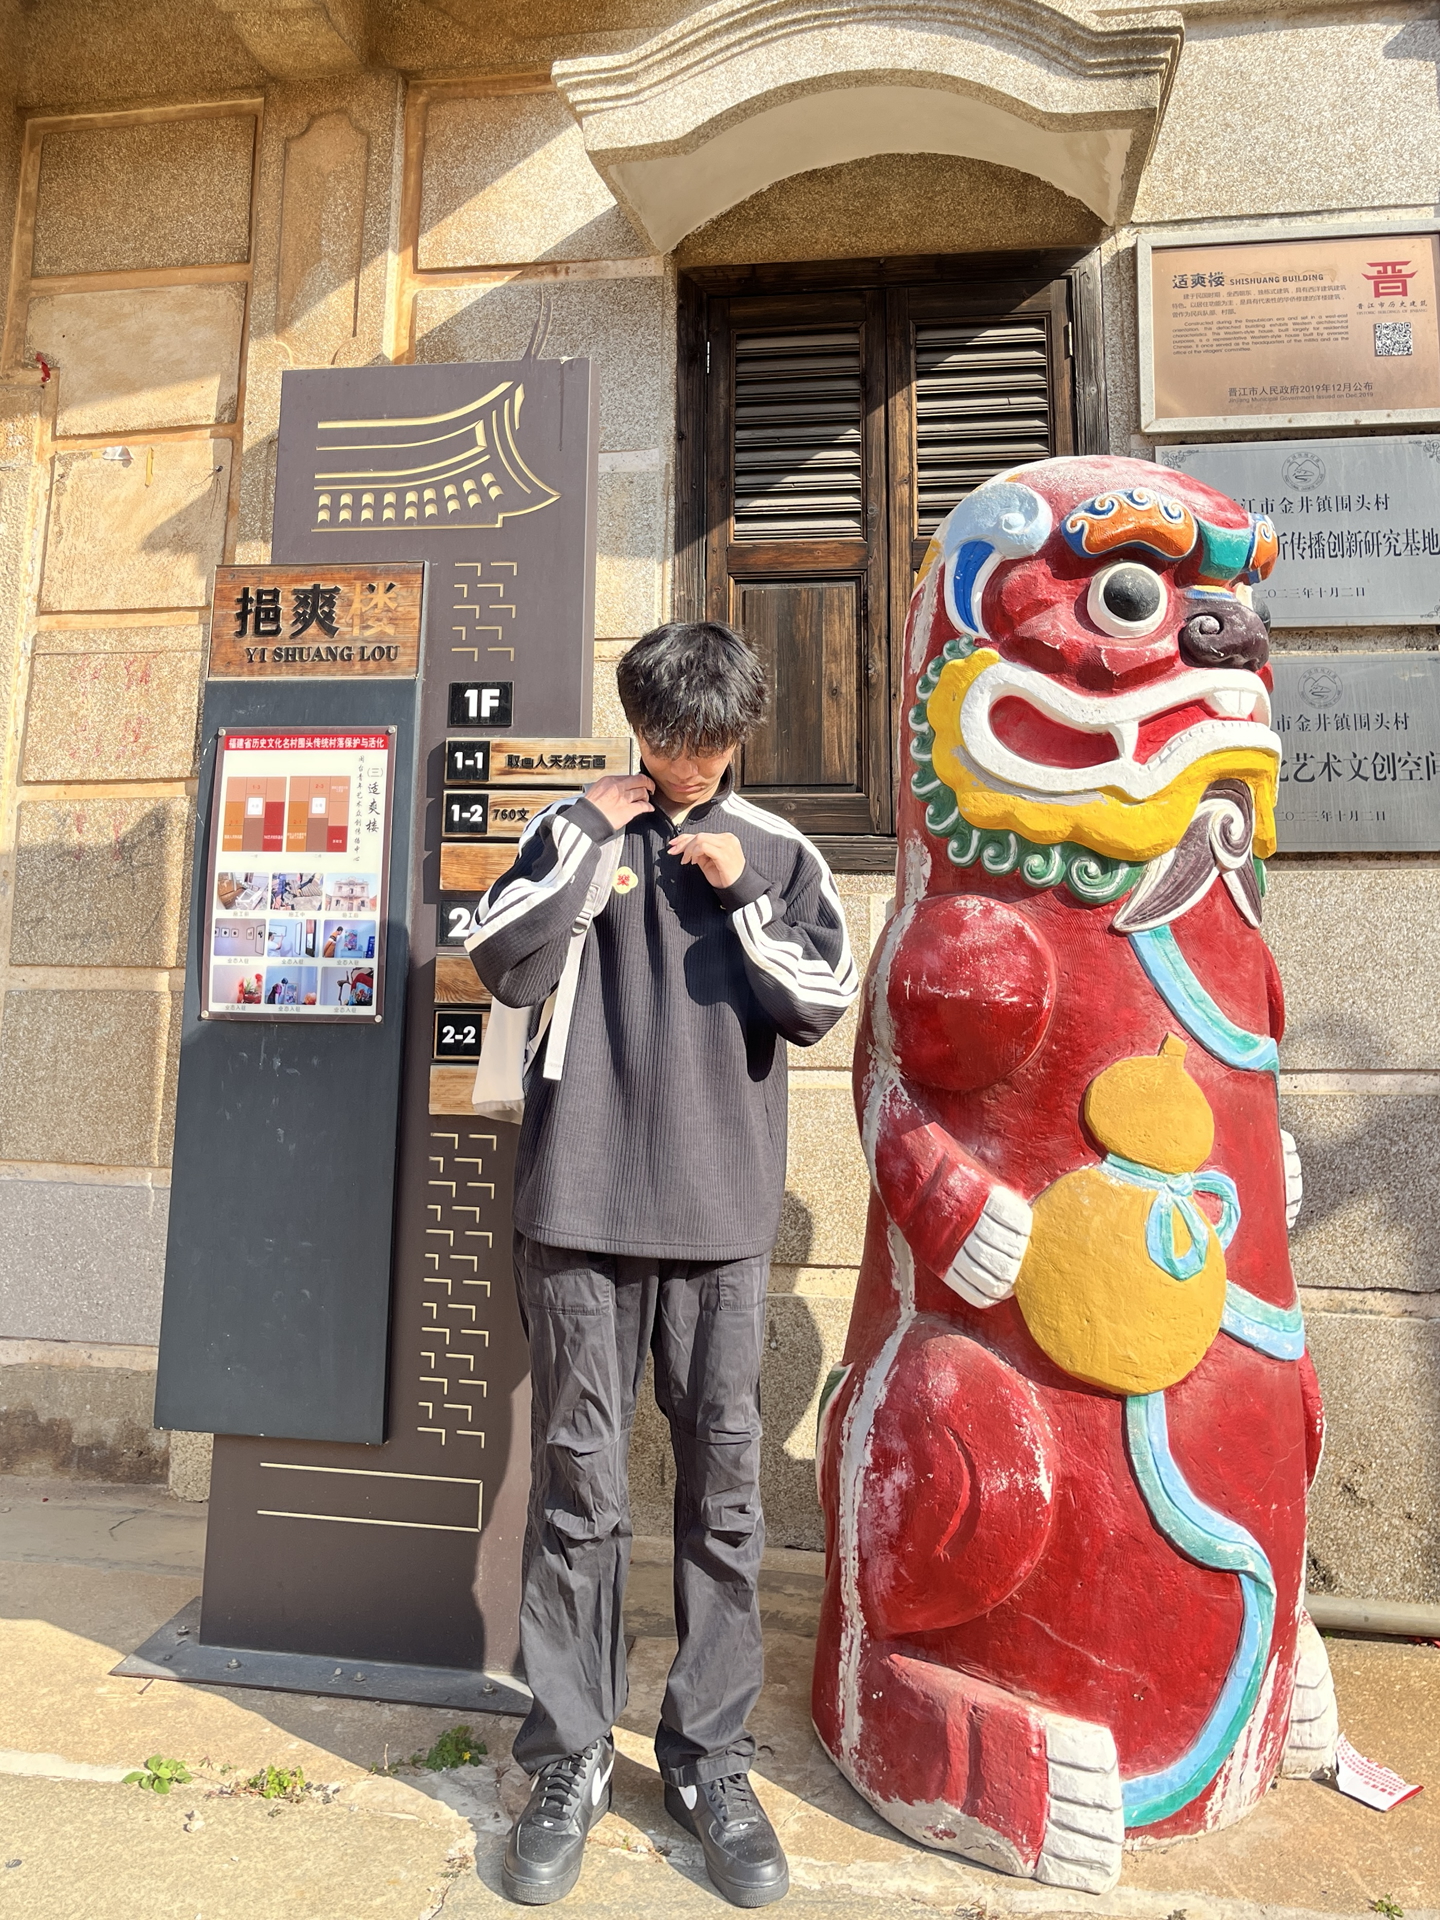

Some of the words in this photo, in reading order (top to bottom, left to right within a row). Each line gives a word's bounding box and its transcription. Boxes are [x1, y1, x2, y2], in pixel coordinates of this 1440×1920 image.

[1172, 271, 1225, 289] 适爽楼
[1230, 276, 1280, 286] SHISHUANG
[1282, 274, 1324, 283] BUILDING
[1361, 260, 1418, 298] 晋
[1228, 381, 1373, 397] 晋江市人民政府2019年12月公布
[1232, 493, 1391, 515] 江市金井镇围头村
[234, 582, 399, 639] 挹爽楼
[246, 647, 268, 664] YI
[273, 645, 354, 663] SHUANG
[359, 645, 400, 662] LOU
[464, 688, 500, 718] 1F
[228, 737, 384, 749] 福建省历史文化名村围头传统村落保护与活化
[454, 751, 484, 770] 1-1
[366, 782, 380, 833] 适爽楼
[451, 804, 483, 822] 1-2
[441, 1025, 476, 1044] 2-2
